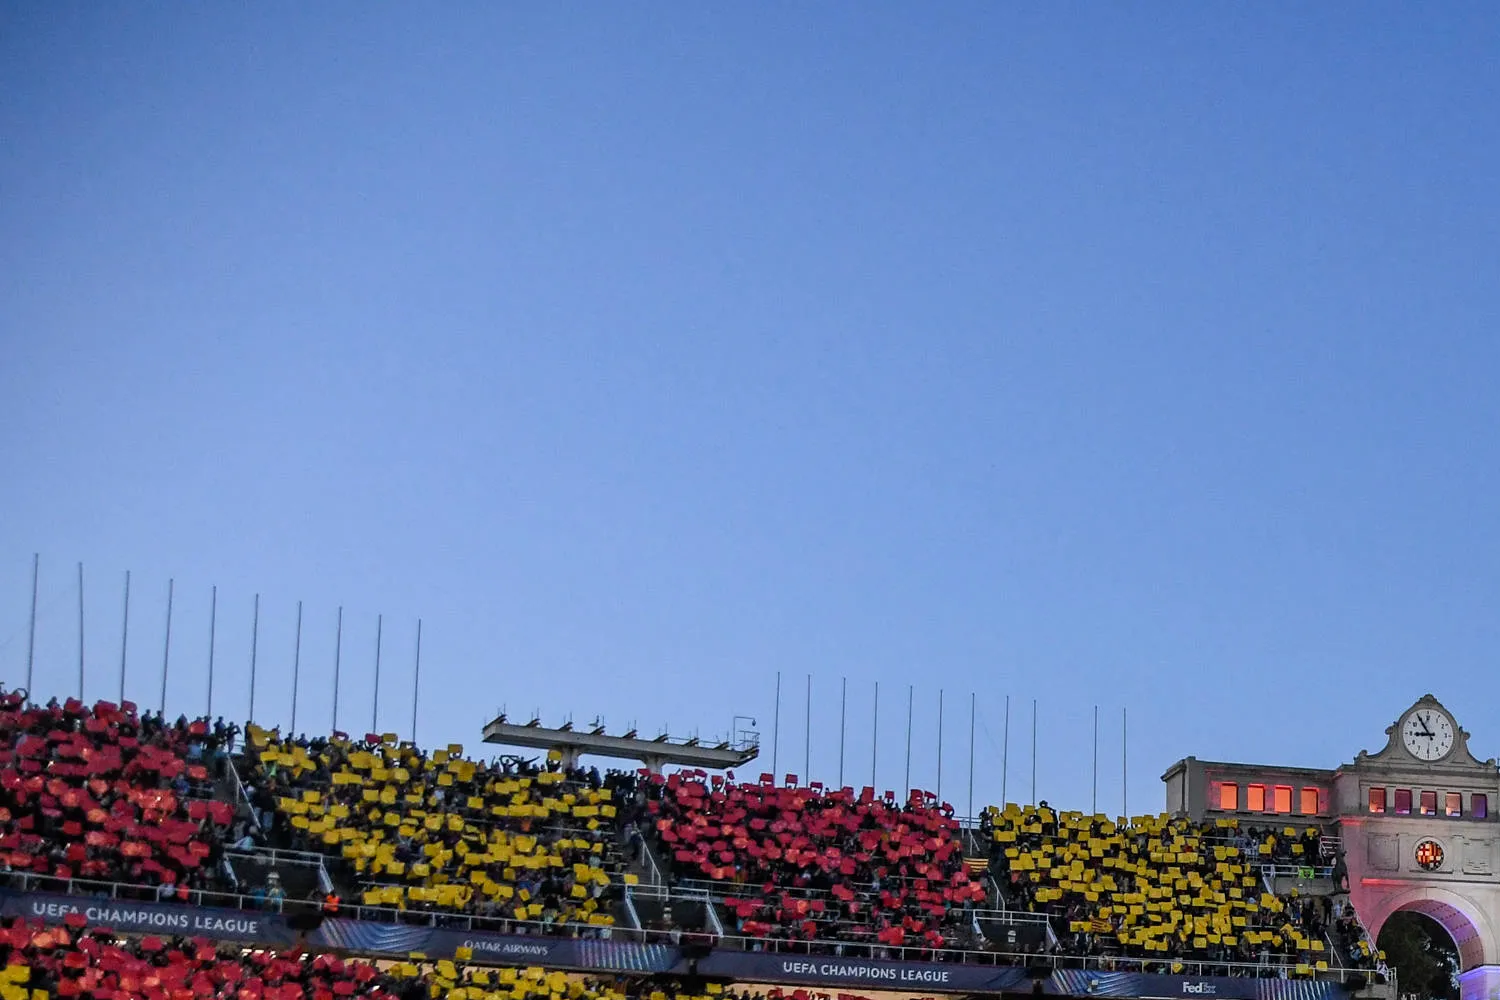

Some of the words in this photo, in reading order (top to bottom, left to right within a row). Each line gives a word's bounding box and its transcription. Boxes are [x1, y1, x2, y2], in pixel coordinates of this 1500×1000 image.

[33, 902, 78, 917] UEFA
[86, 907, 189, 927] CHAMPIONS
[195, 915, 258, 933] LEAGUE
[463, 940, 500, 952] QATAR
[502, 943, 548, 955] AIRWAYS
[783, 961, 817, 974] UEFA
[821, 964, 896, 979] CHAMPIONS
[900, 970, 949, 982] LEAGUE
